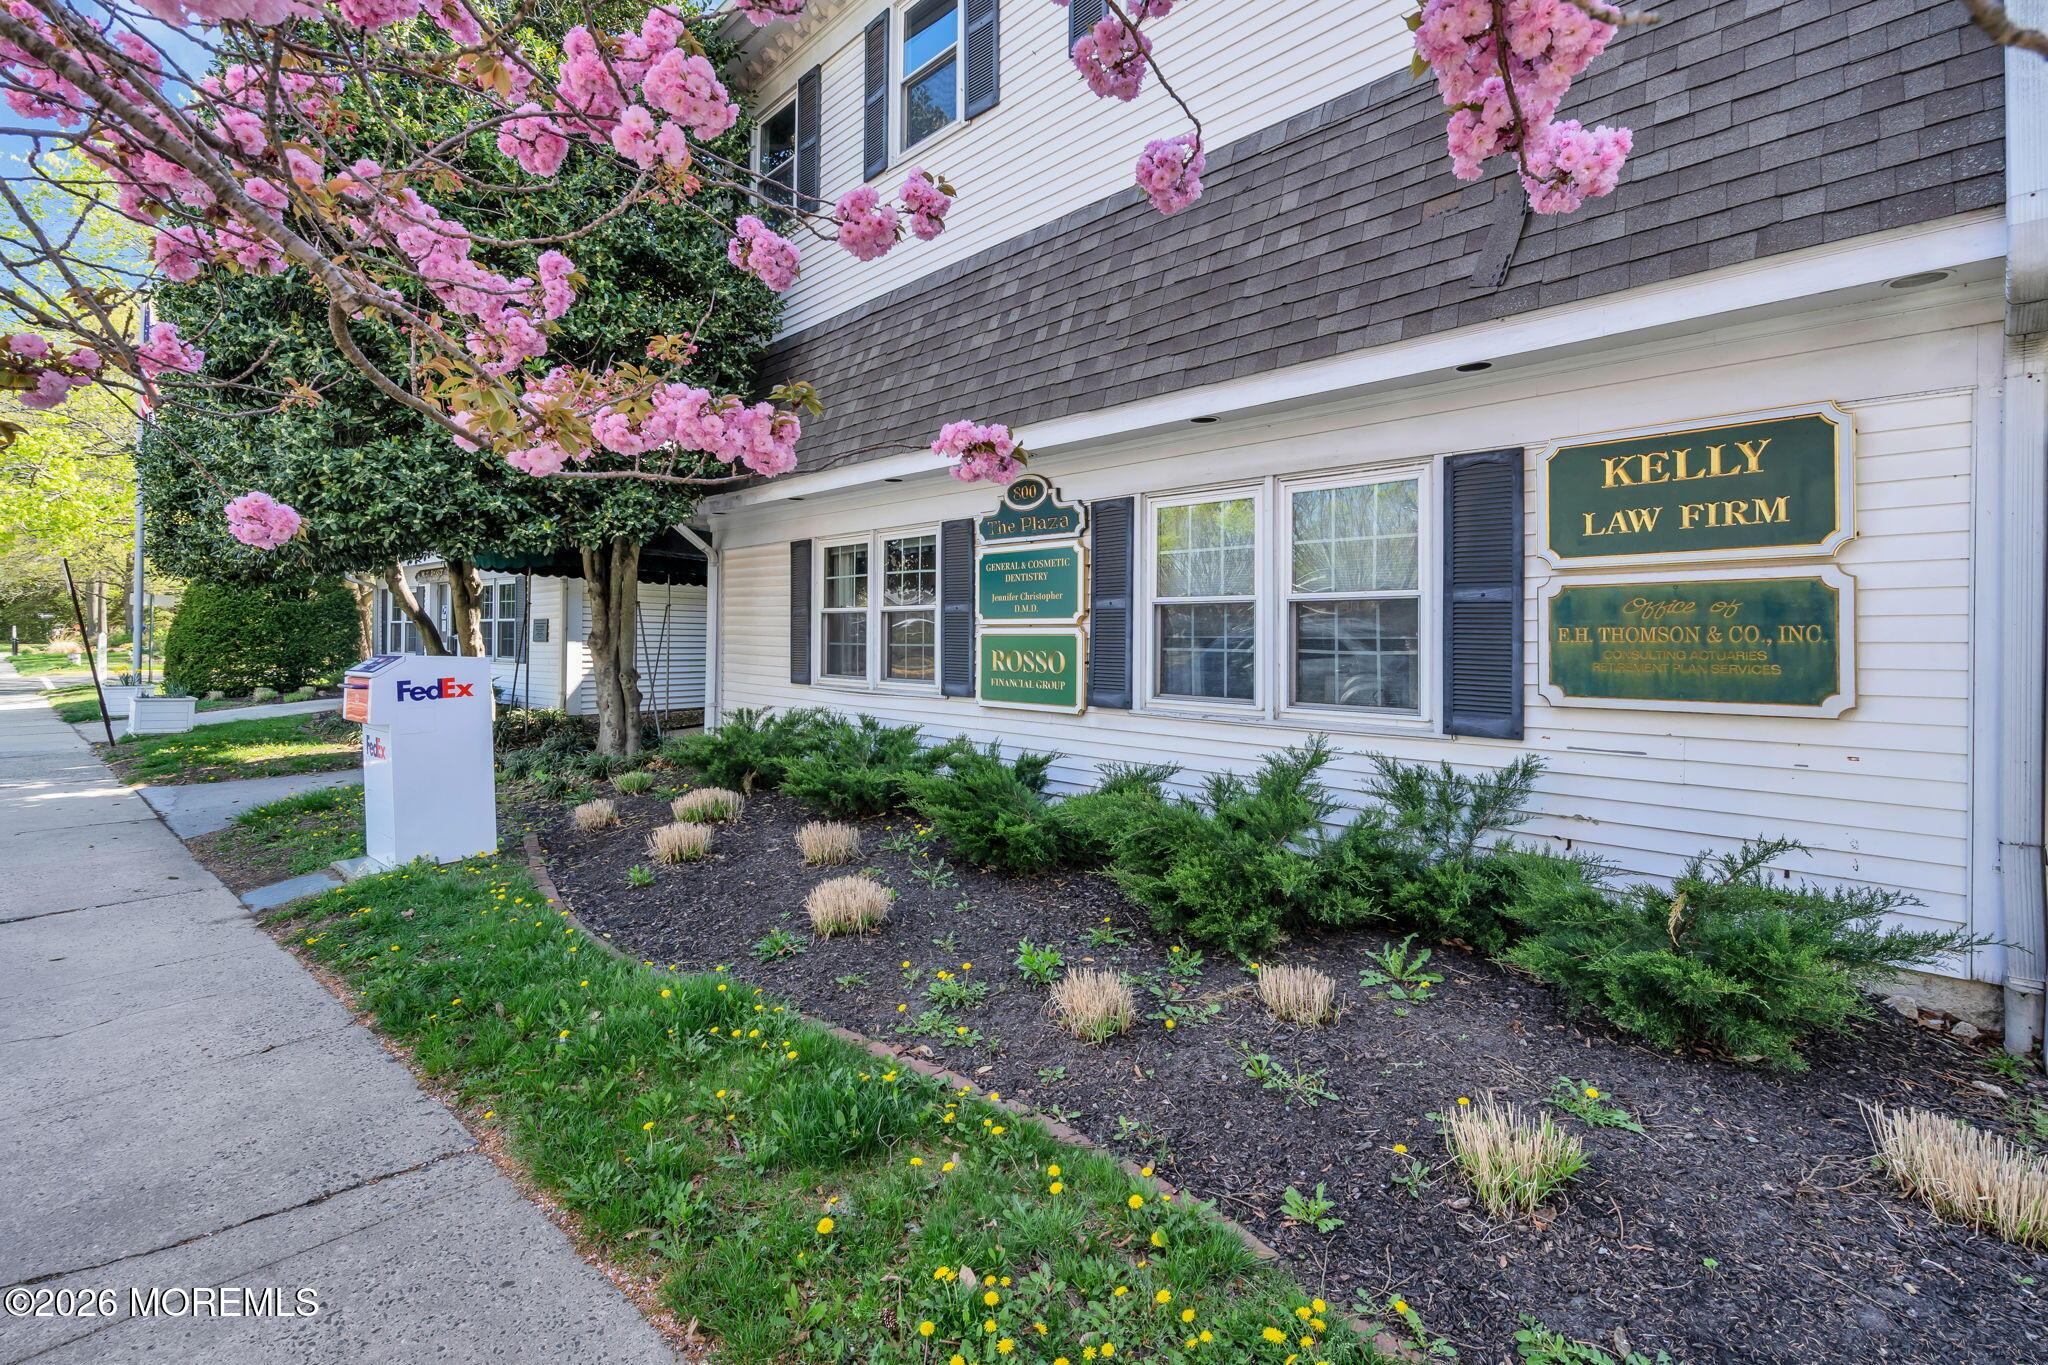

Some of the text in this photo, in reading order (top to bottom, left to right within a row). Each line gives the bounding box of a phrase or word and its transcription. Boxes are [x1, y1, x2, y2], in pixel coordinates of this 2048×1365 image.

[1601, 438, 1772, 489] KELLY
[1013, 485, 1037, 500] 800
[986, 514, 1070, 536] The Plaza
[1582, 496, 1790, 537] LAW FIRM
[985, 558, 1071, 572] GENERAL & COSMETIC
[1004, 572, 1049, 583] DENTISTRY
[991, 590, 1064, 603] Jennifer Christopher
[1014, 604, 1039, 613] D.M.D.
[1622, 597, 1745, 620] Office of
[1557, 624, 1828, 647] E.H. THOMSON & CO., INC.
[991, 649, 1066, 674] ROSSO
[1602, 650, 1769, 661] CONSULTING ACTUARIES
[1592, 663, 1782, 676] RETIREMENT PLAN SERVICES
[396, 677, 475, 702] FedEx
[990, 678, 1066, 690] FINANCIAL GROUP
[366, 734, 386, 760] FedEx
